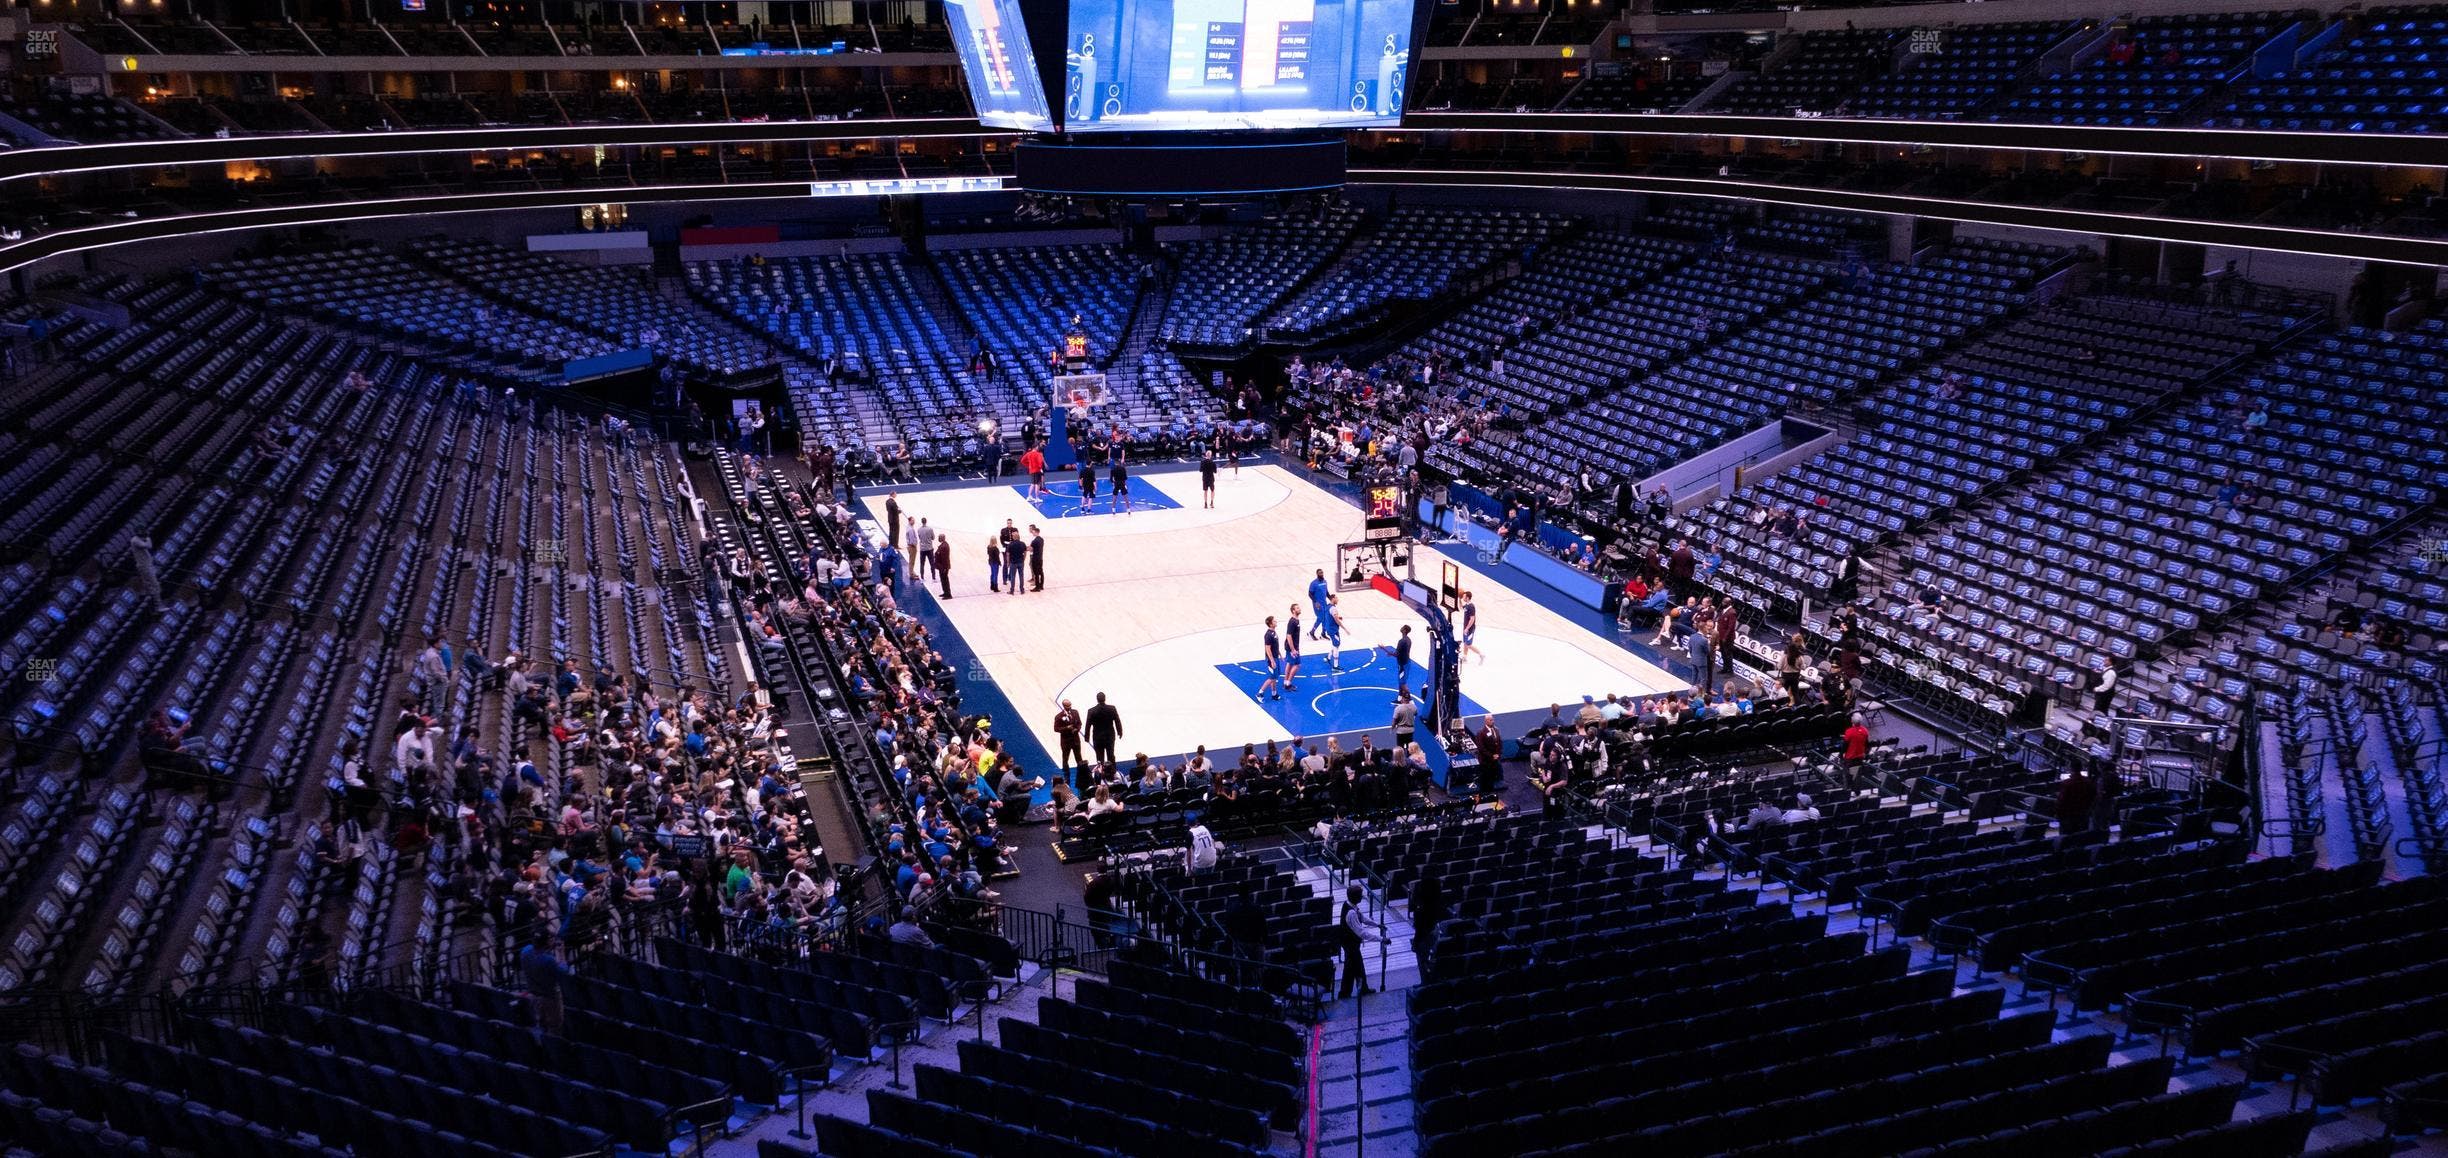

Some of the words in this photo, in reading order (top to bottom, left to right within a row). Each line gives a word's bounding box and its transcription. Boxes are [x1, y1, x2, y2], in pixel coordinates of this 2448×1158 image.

[1068, 345, 1083, 356] 24
[1373, 500, 1394, 517] 24
[1739, 636, 1745, 645] G
[1750, 641, 1756, 650] G
[1761, 646, 1767, 655] G
[1772, 651, 1778, 660] G
[1732, 664, 1757, 681] GEICO
[1807, 668, 1813, 677] G
